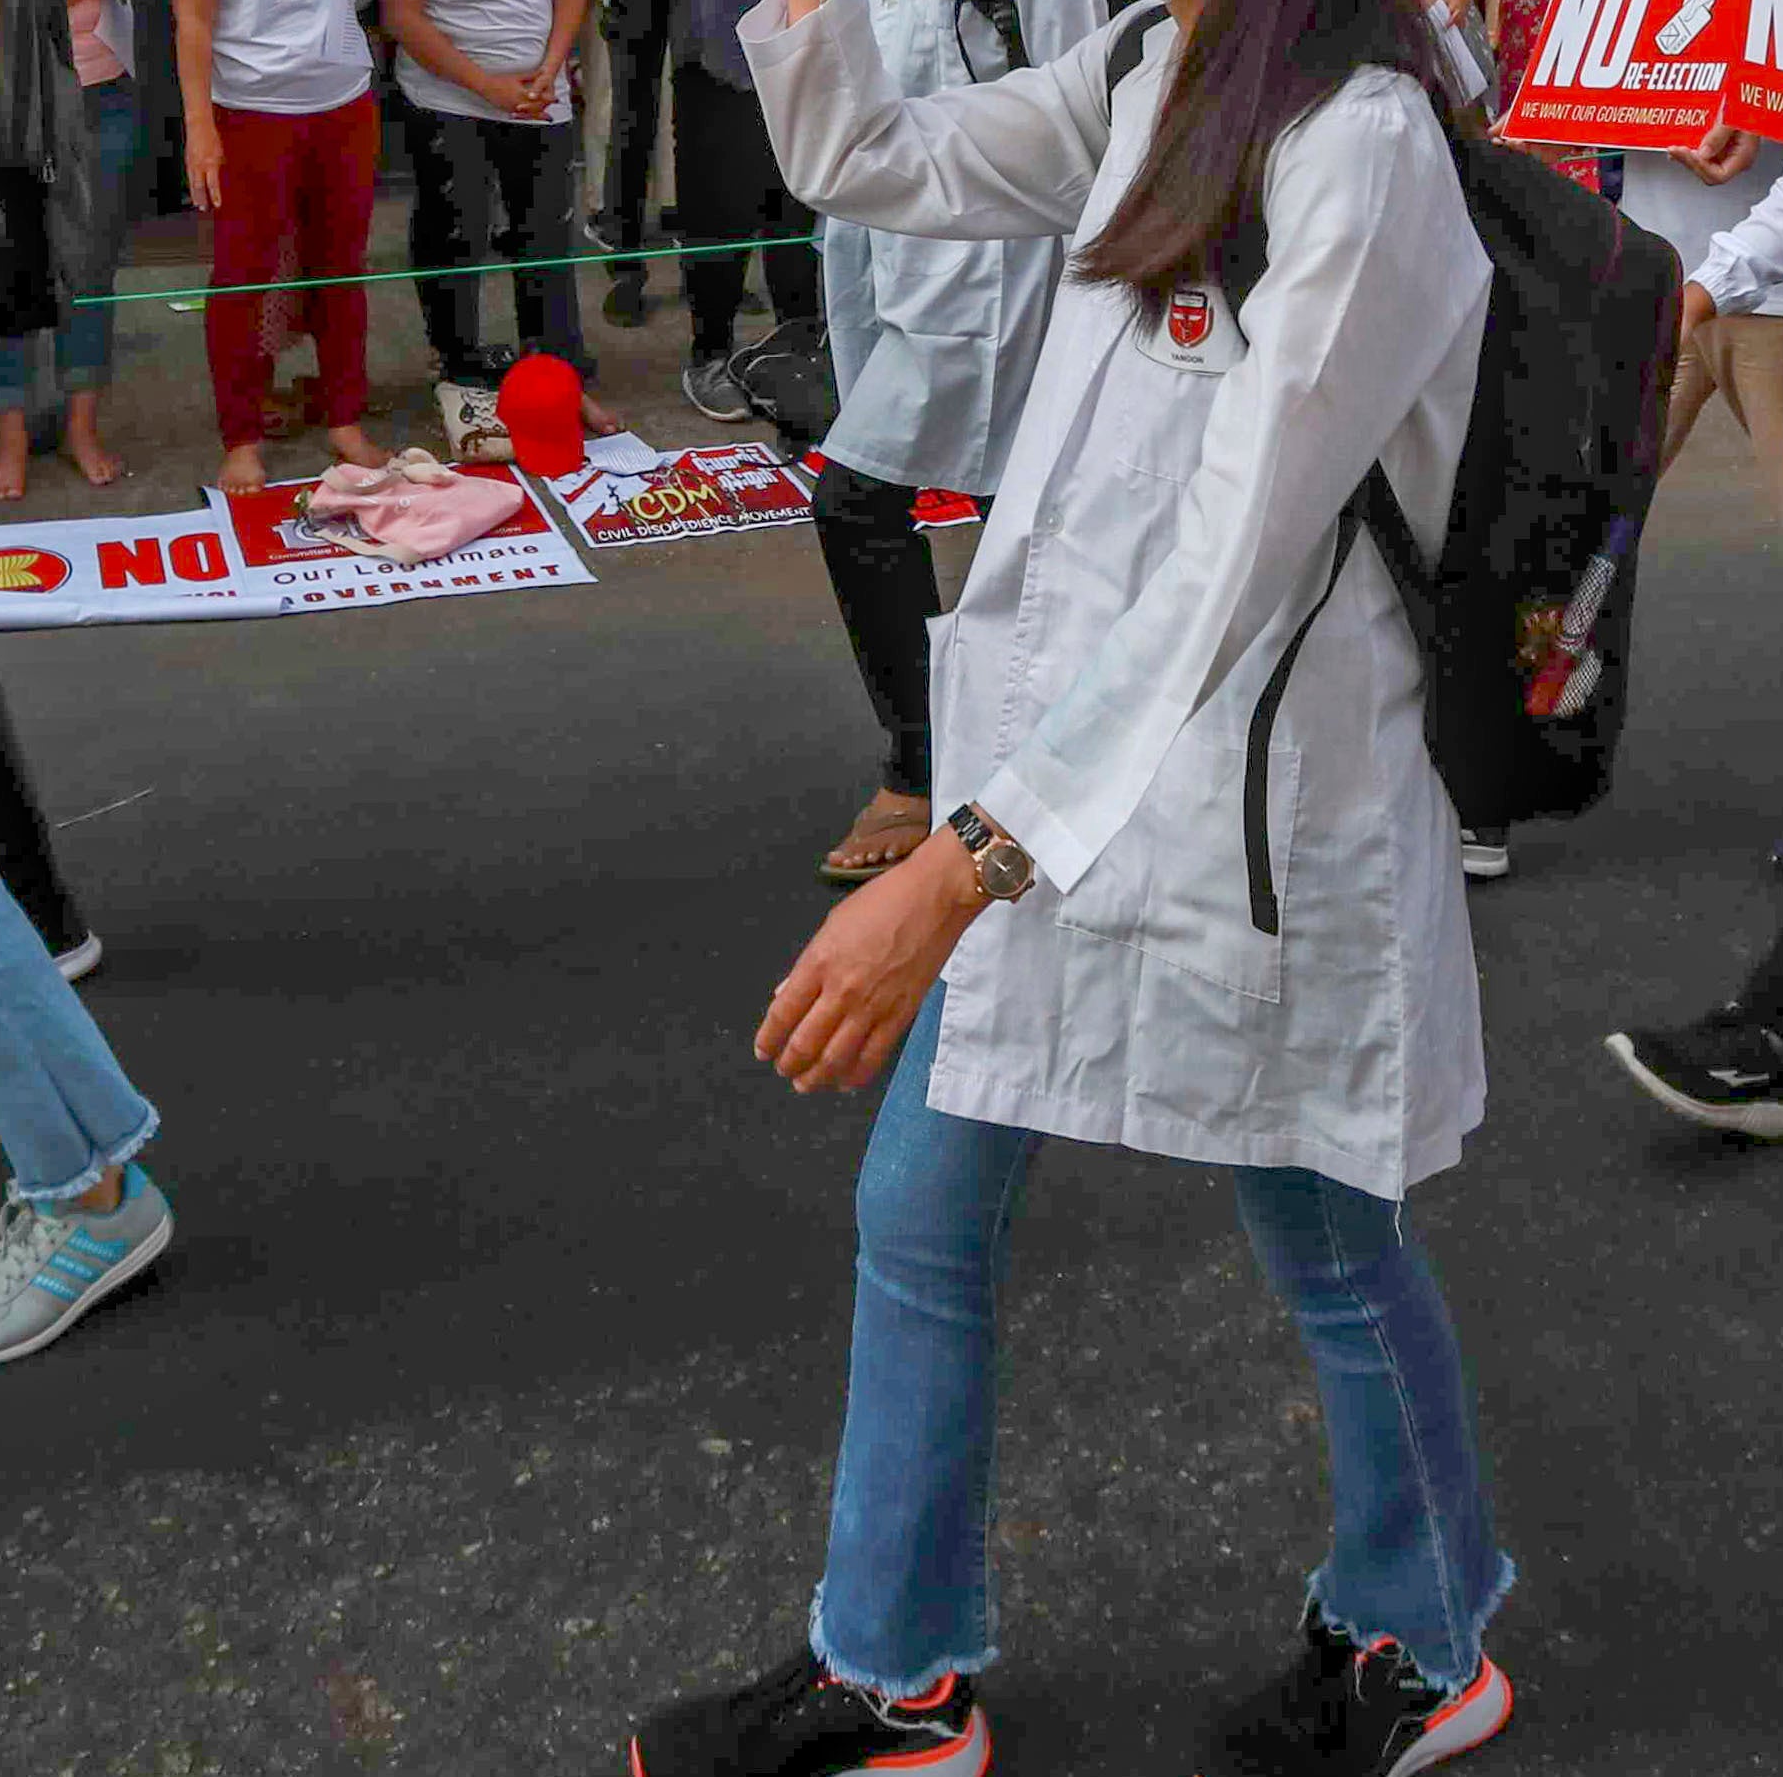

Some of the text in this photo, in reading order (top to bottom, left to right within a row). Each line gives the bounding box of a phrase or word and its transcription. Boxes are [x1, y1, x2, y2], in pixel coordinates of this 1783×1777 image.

[1622, 62, 1727, 91] RE-ELECTION
[1740, 82, 1763, 107] WE
[1521, 102, 1709, 127] WE WANT OUR GOVERNMENT BACK
[633, 485, 722, 520] CDM
[597, 526, 634, 542] CIVIL
[738, 506, 811, 523] MOVEMENT
[97, 532, 231, 590] NO
[274, 565, 336, 584] Our
[281, 564, 560, 611] OVERNMENT
